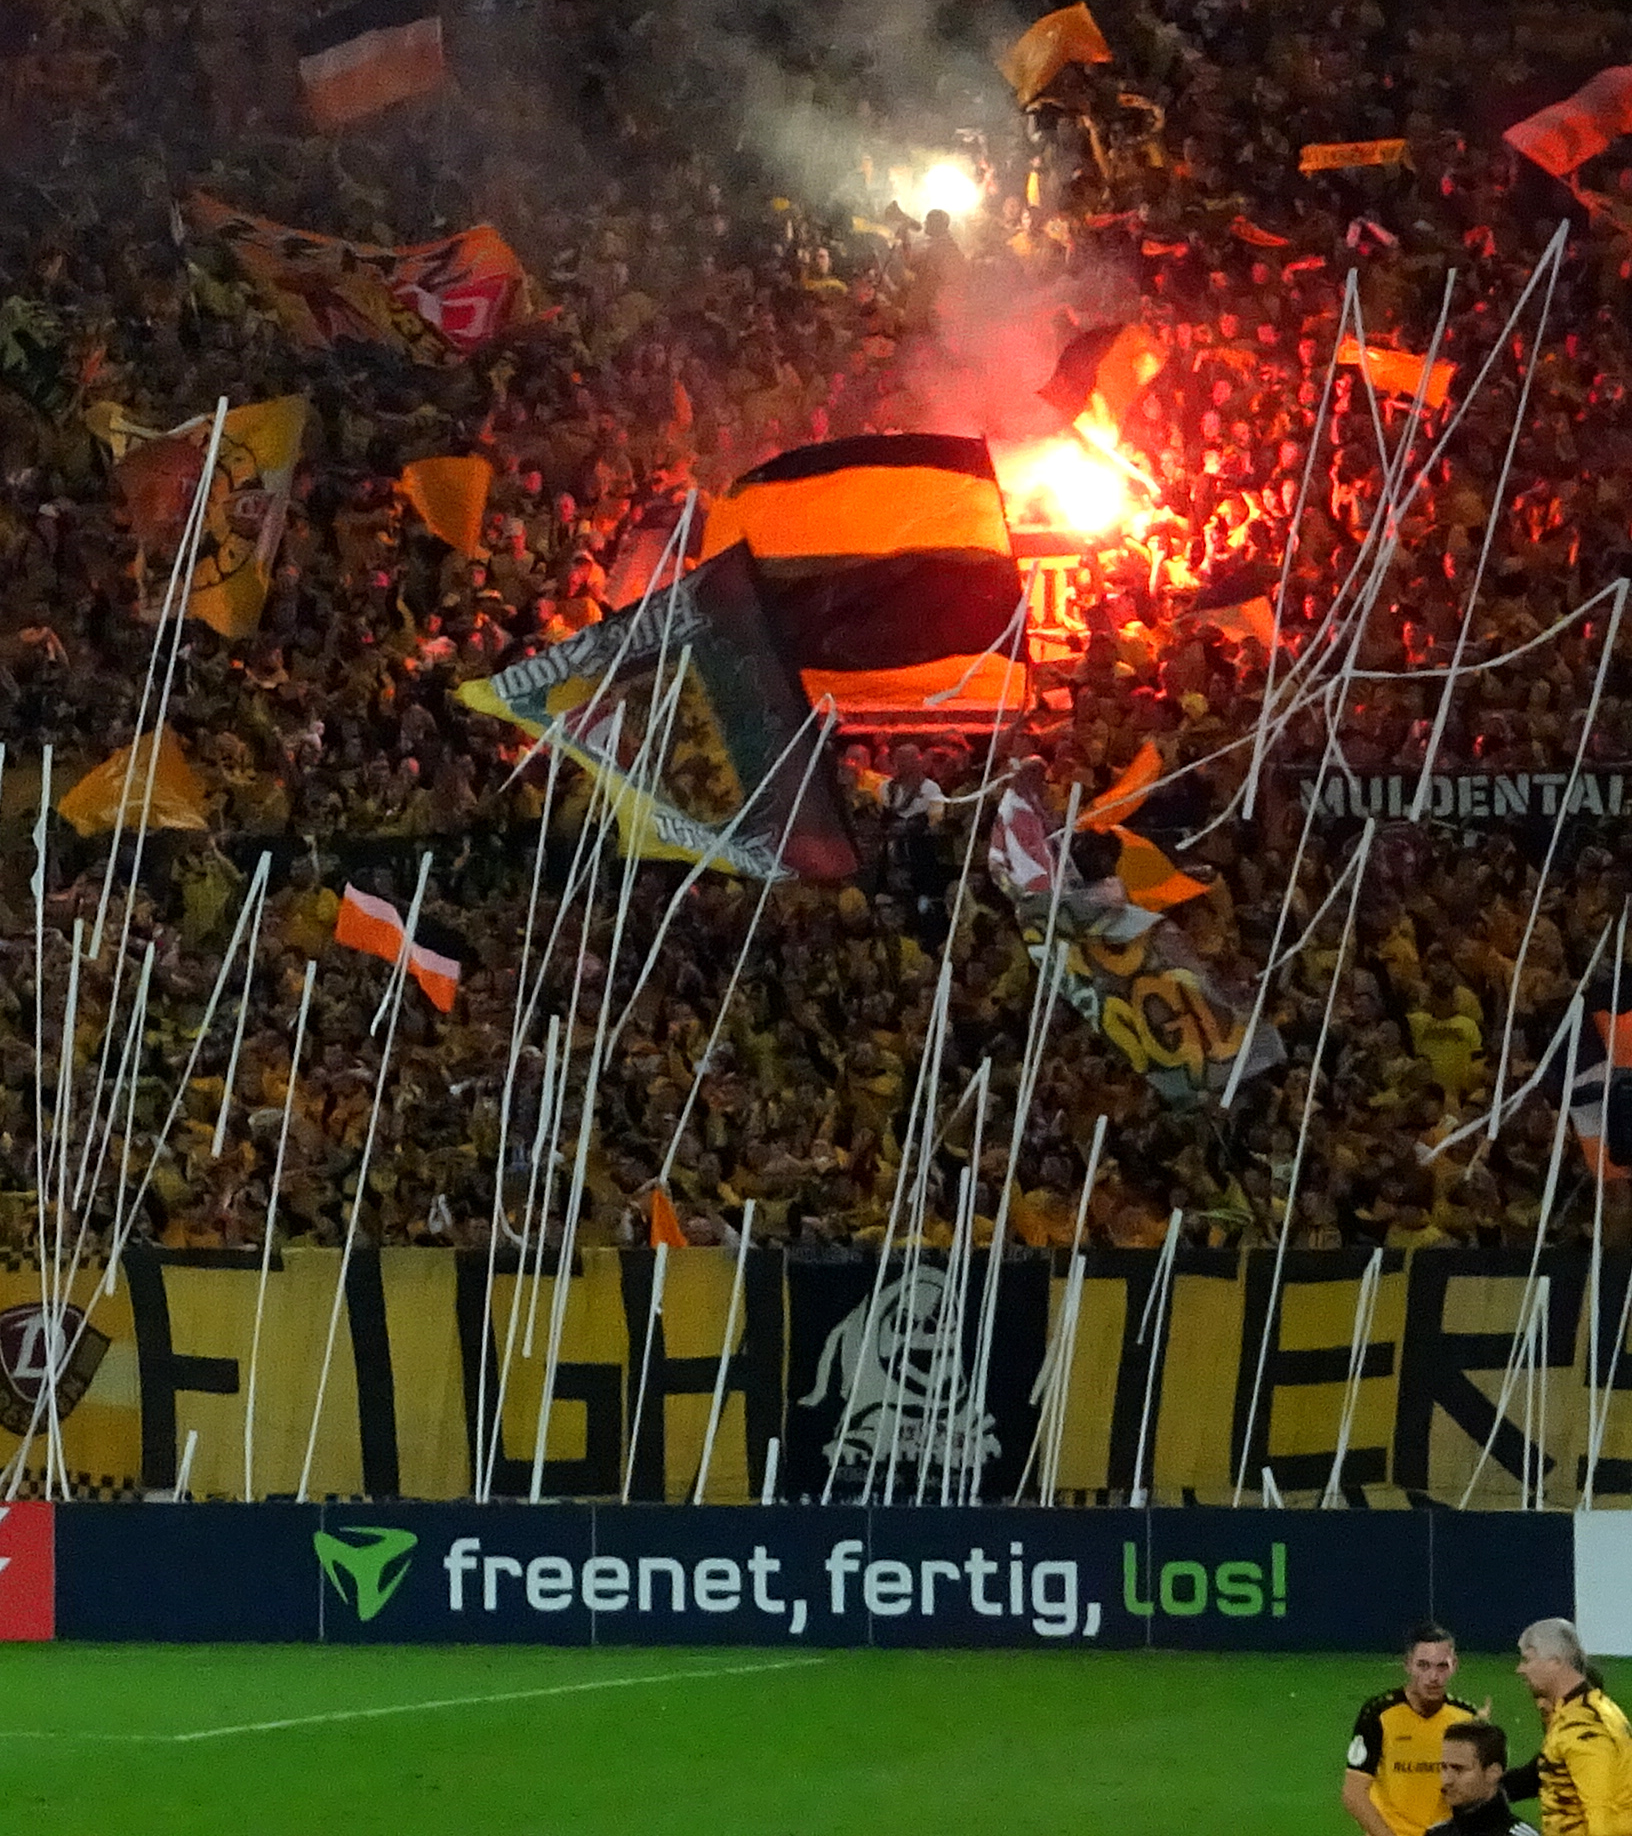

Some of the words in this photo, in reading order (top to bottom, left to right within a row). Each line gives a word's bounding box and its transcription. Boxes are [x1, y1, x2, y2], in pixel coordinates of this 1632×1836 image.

[443, 1537, 810, 1634] freenet,
[825, 1537, 1105, 1638] fertig,
[1121, 1540, 1290, 1618] los!
